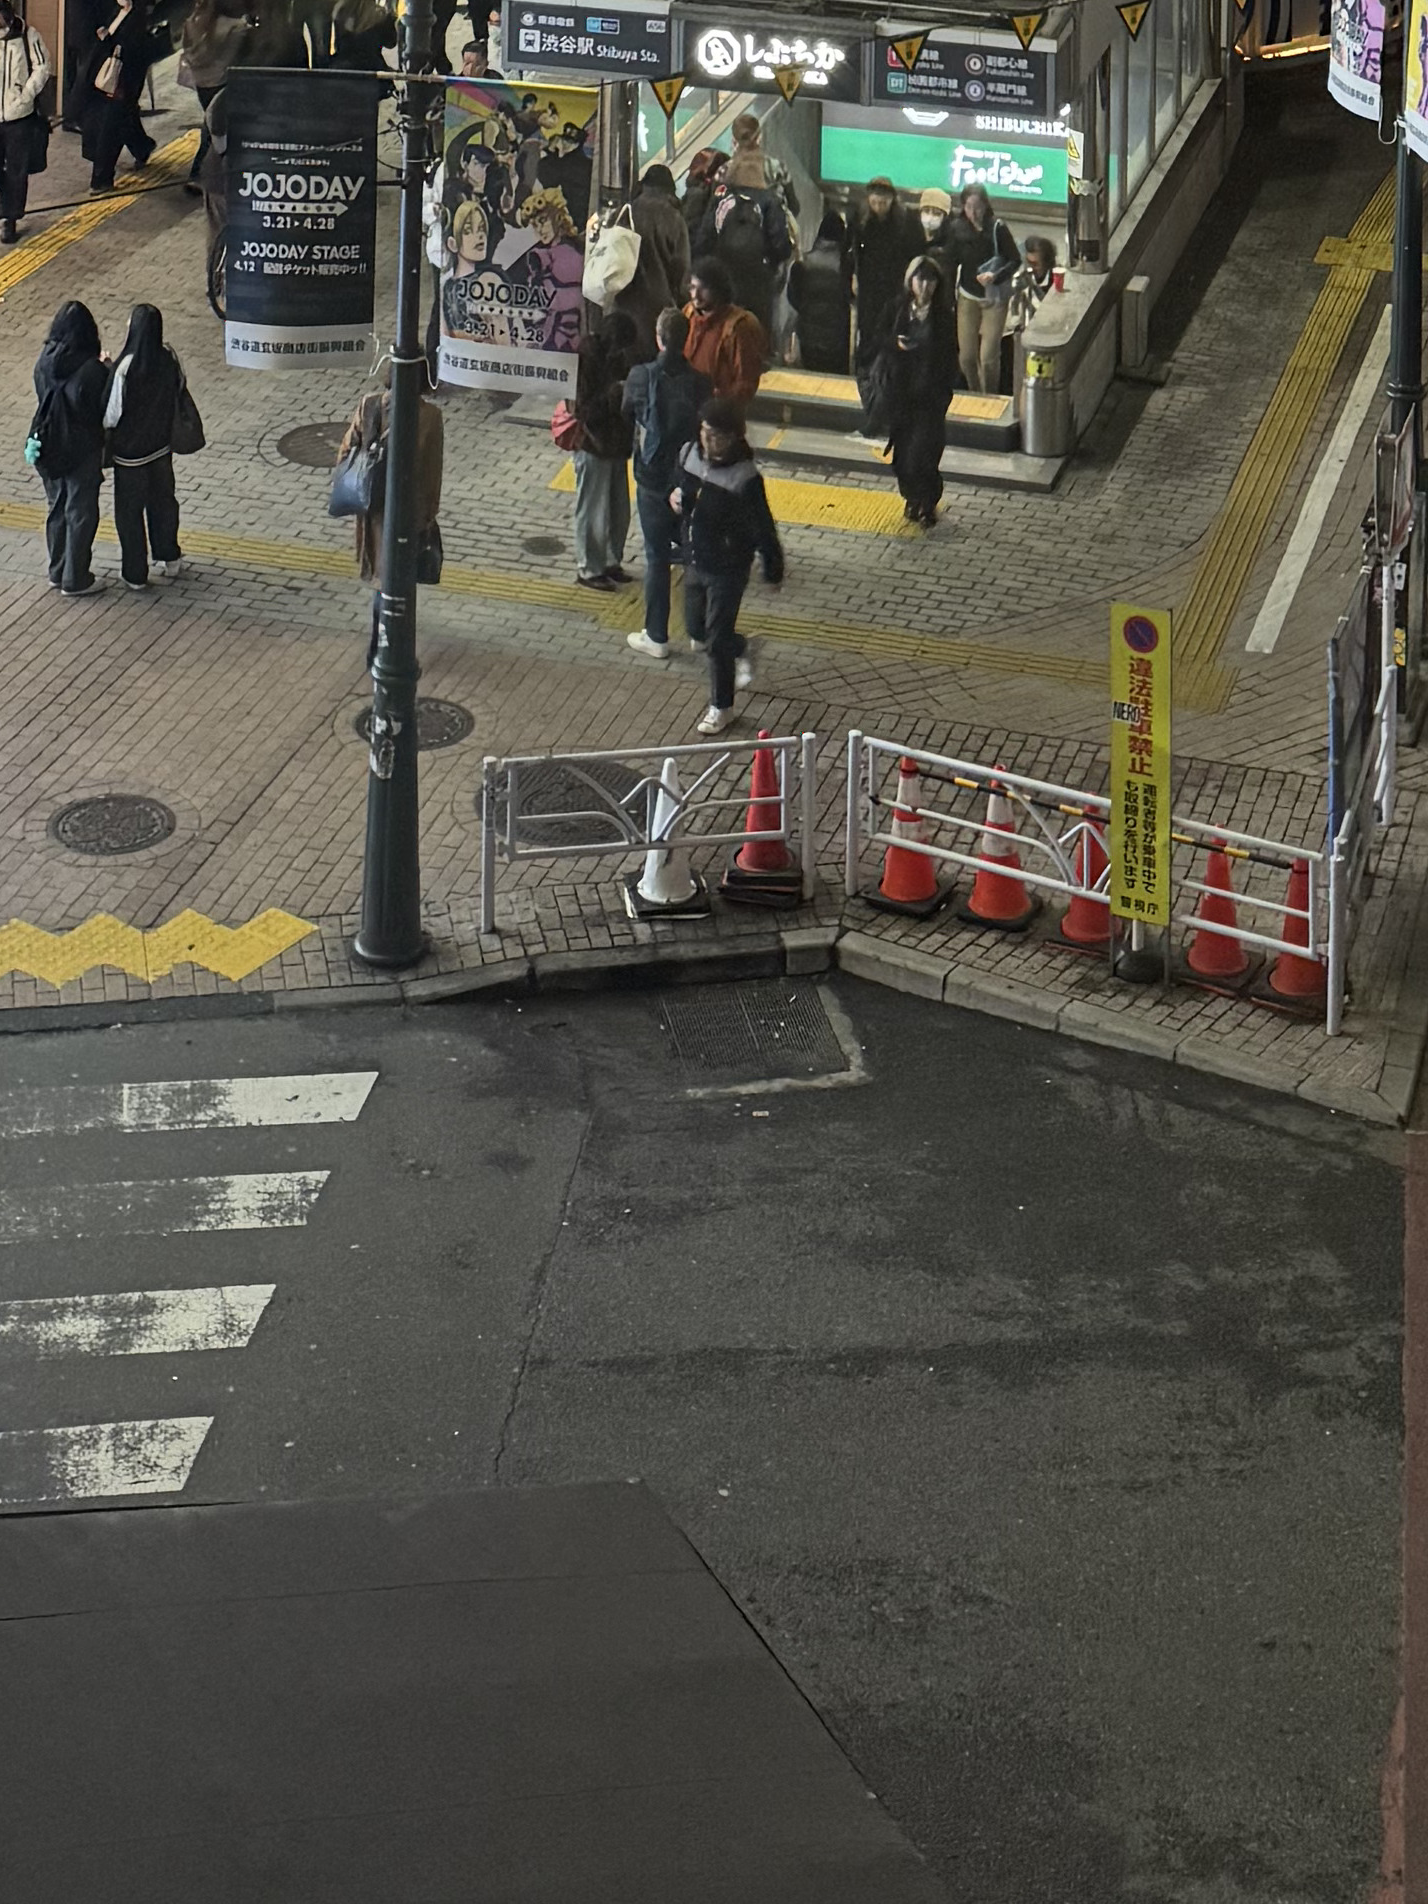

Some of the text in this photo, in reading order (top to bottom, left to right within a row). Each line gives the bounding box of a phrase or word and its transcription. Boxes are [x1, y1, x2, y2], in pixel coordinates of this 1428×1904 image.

[541, 32, 595, 57] 渋谷駅
[596, 44, 638, 62] Shibuya
[238, 171, 366, 201] JOJODAY
[262, 216, 336, 230] 3.21 4.28
[240, 241, 361, 260] JOJODAY STAGE
[233, 260, 256, 272] 4.12
[458, 279, 558, 308] JOJODAY
[1113, 700, 1141, 724] NERO
